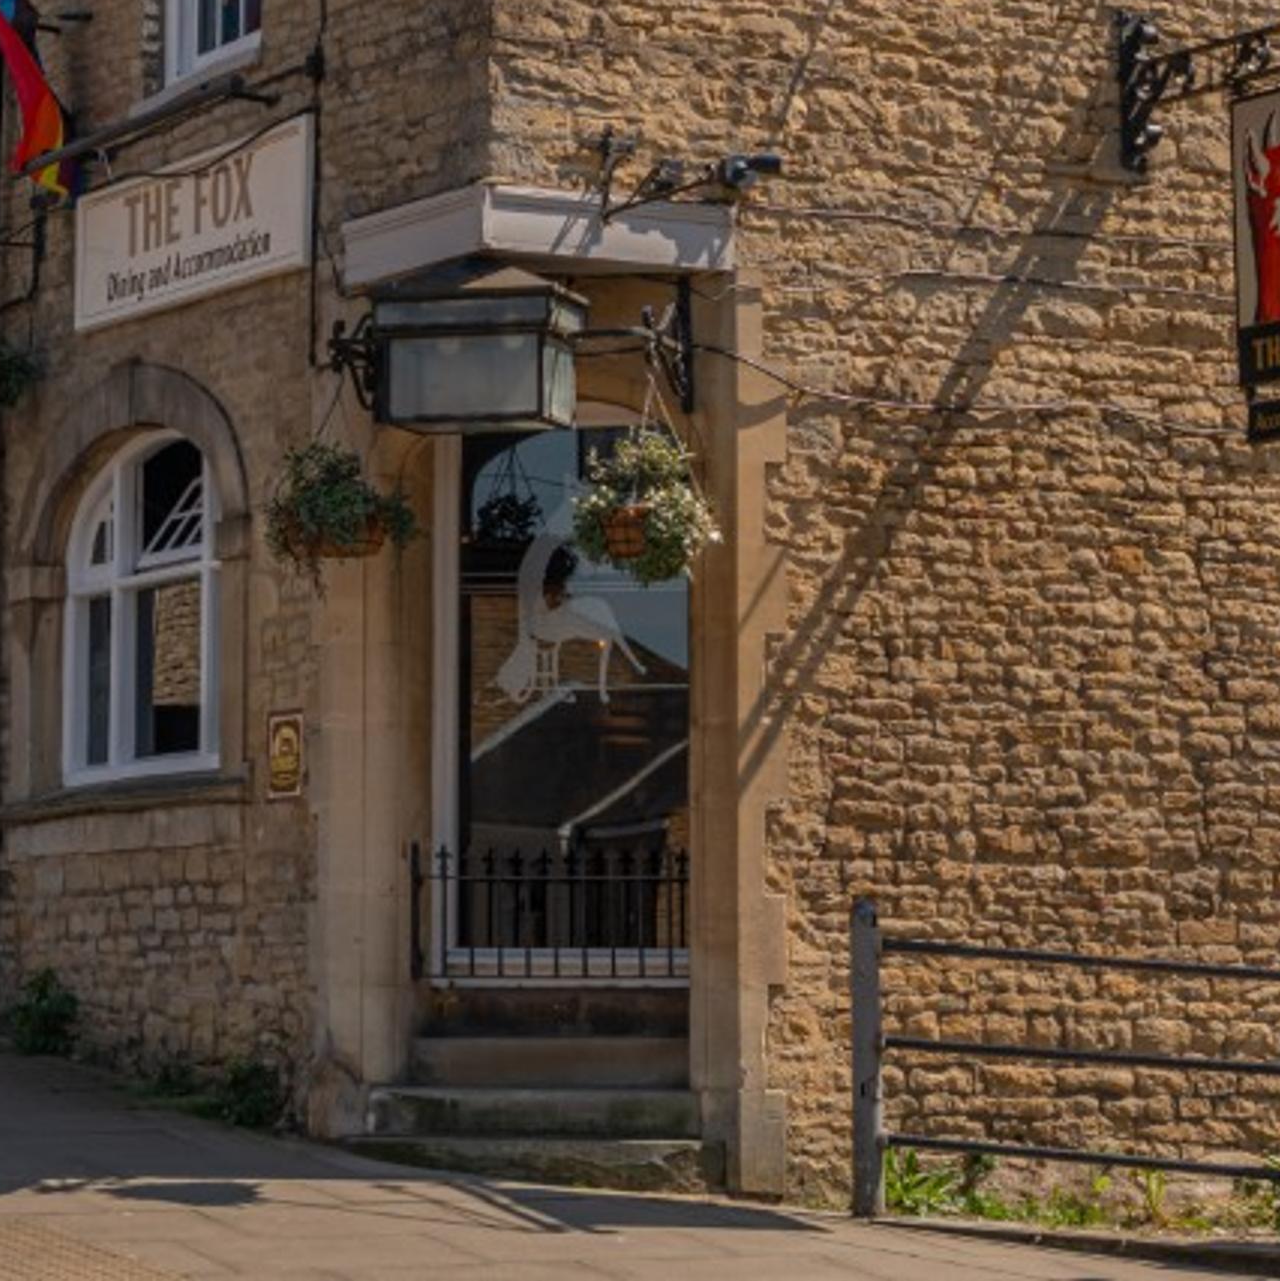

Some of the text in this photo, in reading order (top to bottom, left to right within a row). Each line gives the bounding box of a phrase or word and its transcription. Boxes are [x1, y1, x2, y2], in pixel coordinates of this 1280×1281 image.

[125, 151, 255, 258] THE FOX
[106, 231, 271, 303] Dining and Accommodation
